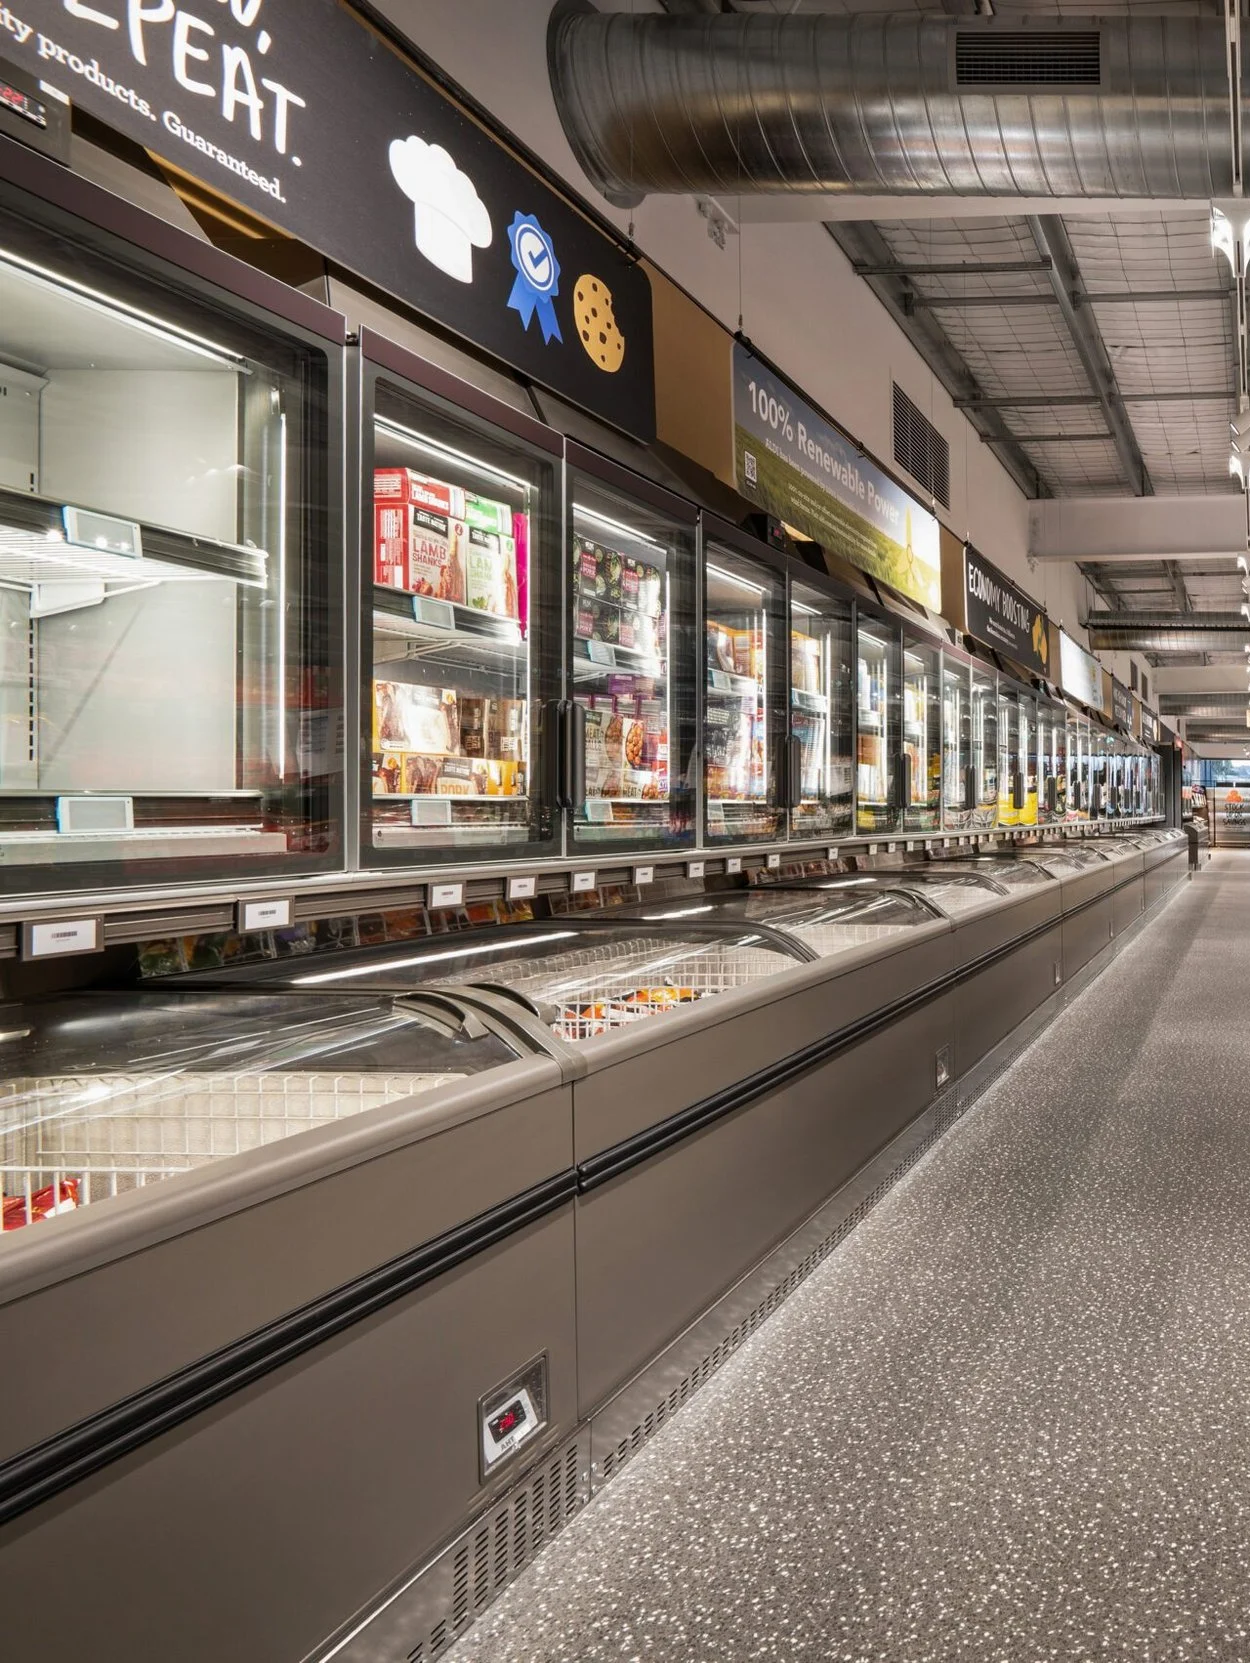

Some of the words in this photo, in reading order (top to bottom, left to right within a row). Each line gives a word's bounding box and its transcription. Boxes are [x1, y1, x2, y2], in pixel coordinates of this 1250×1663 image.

[64, 0, 306, 167] PEAT.
[37, 33, 157, 122] products.
[162, 110, 286, 203] Guaranteed.
[749, 381, 794, 442] 100%
[797, 421, 865, 500] Renewable
[867, 480, 900, 525] Power
[412, 552, 442, 568] SHANKS
[413, 538, 446, 559] LAMB
[968, 562, 1001, 613] ECONOMY
[1002, 591, 1030, 634] BOOSTING
[1222, 818, 1247, 826] SAVINGS
[1224, 803, 1245, 811] STOCK
